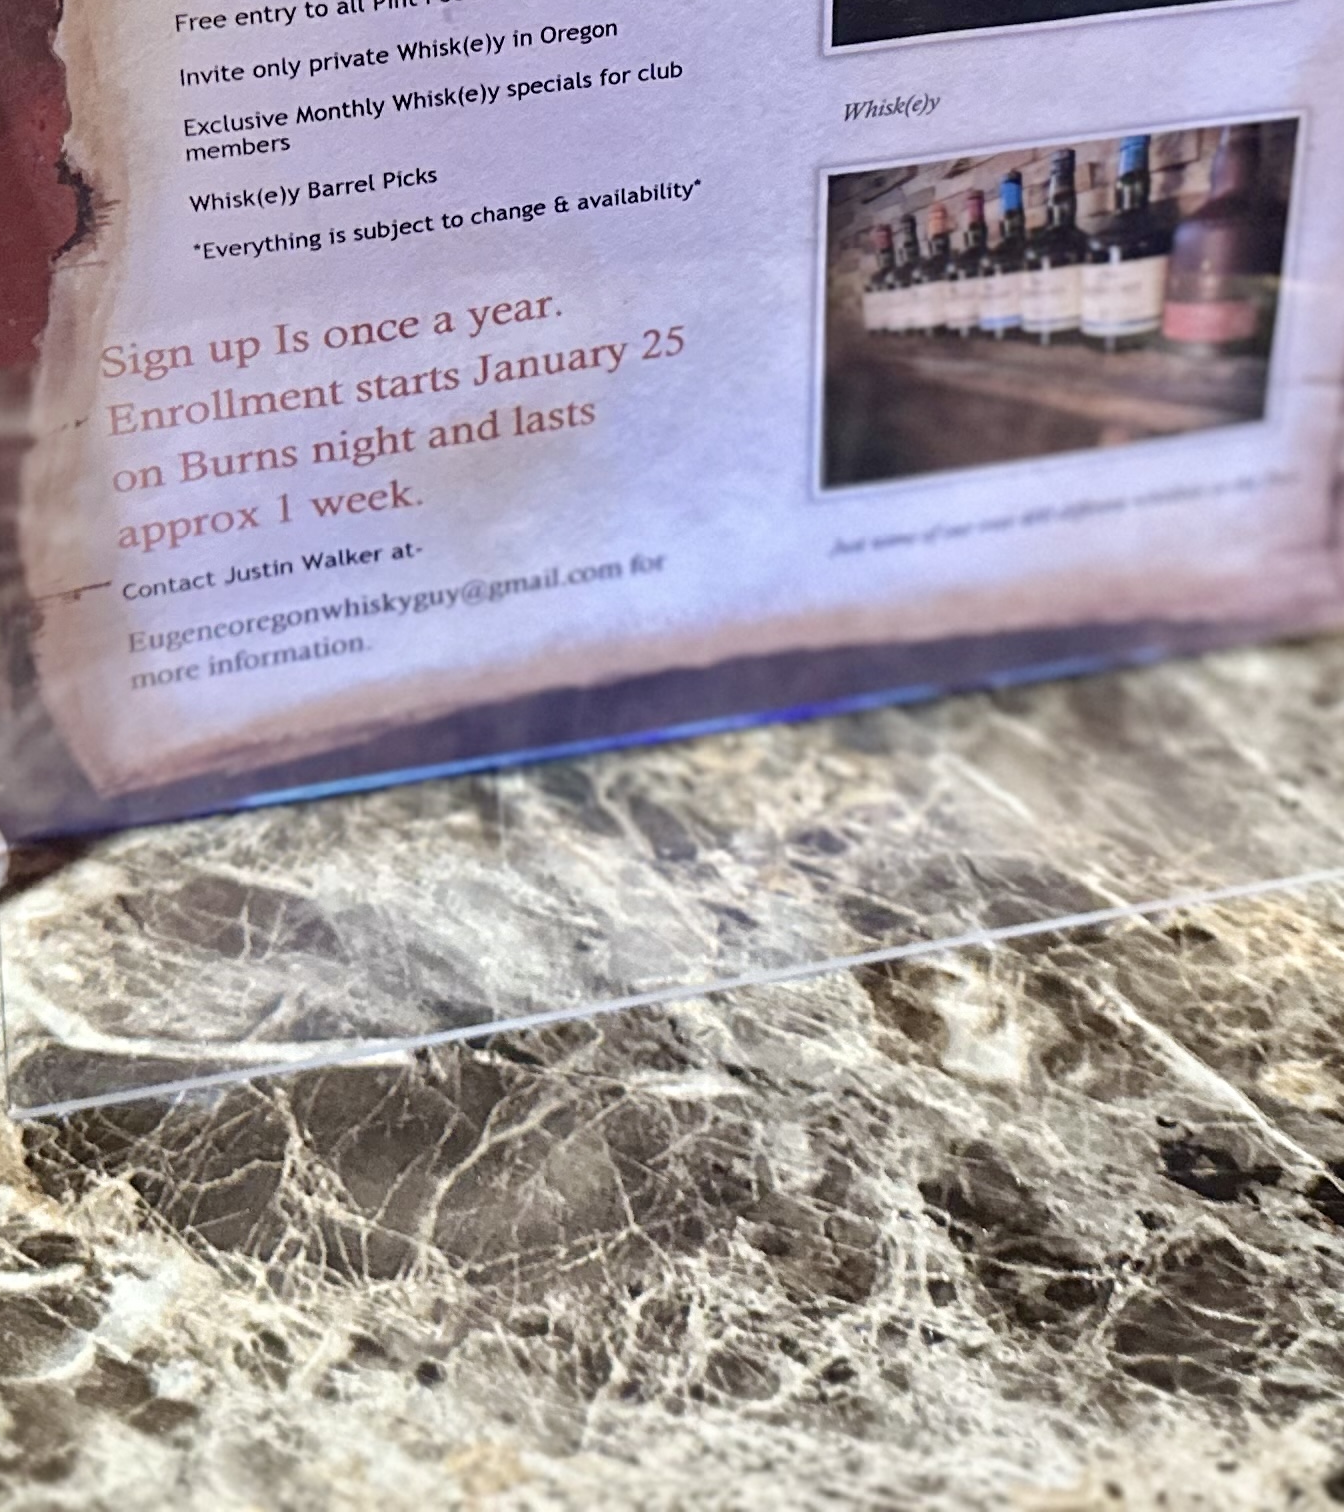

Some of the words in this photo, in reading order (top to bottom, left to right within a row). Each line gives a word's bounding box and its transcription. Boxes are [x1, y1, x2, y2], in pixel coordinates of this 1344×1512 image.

[174, 9, 227, 32] Free
[234, 4, 296, 29] entry
[304, 0, 329, 18] to
[179, 63, 245, 87] Invite
[252, 56, 301, 81] only
[308, 46, 390, 75] private
[397, 32, 505, 63] Whisk(e)y
[512, 29, 533, 47] in
[540, 20, 618, 49] Oregon
[183, 110, 288, 137] Exclusive
[295, 97, 385, 125] Monthly
[392, 83, 499, 114] Whisk(e)y
[506, 71, 593, 99] specials
[600, 66, 632, 86] for
[637, 60, 683, 81] club
[843, 92, 942, 123] Whisk(e)y
[185, 136, 291, 162] members
[189, 185, 301, 213] Whisk(e)y
[307, 174, 375, 200] Barrel
[382, 166, 438, 190] Picks
[329, 226, 346, 245] is
[353, 214, 434, 243] subject
[441, 210, 464, 229] to
[470, 199, 546, 228] change
[553, 195, 570, 213] &
[101, 342, 195, 381] Sign
[209, 335, 261, 367] up
[274, 322, 310, 356] Is
[324, 320, 420, 350] once
[433, 311, 455, 335] a
[467, 293, 563, 338] year.
[107, 378, 345, 437] Enrollment
[356, 364, 460, 404] starts
[473, 338, 628, 388] January
[641, 324, 686, 360] 25
[113, 463, 166, 493] on
[178, 445, 299, 483] Burns
[312, 425, 417, 468] night
[428, 409, 501, 449] and
[512, 397, 597, 437] lasts
[117, 502, 261, 551] approx
[276, 493, 292, 524] 1
[309, 480, 424, 519] week.
[122, 570, 216, 601] Contact
[224, 556, 294, 587] Justin
[302, 544, 383, 573] Walker
[390, 541, 423, 560] at-
[629, 550, 668, 578] for
[130, 662, 201, 692] more
[208, 634, 373, 676] information.
